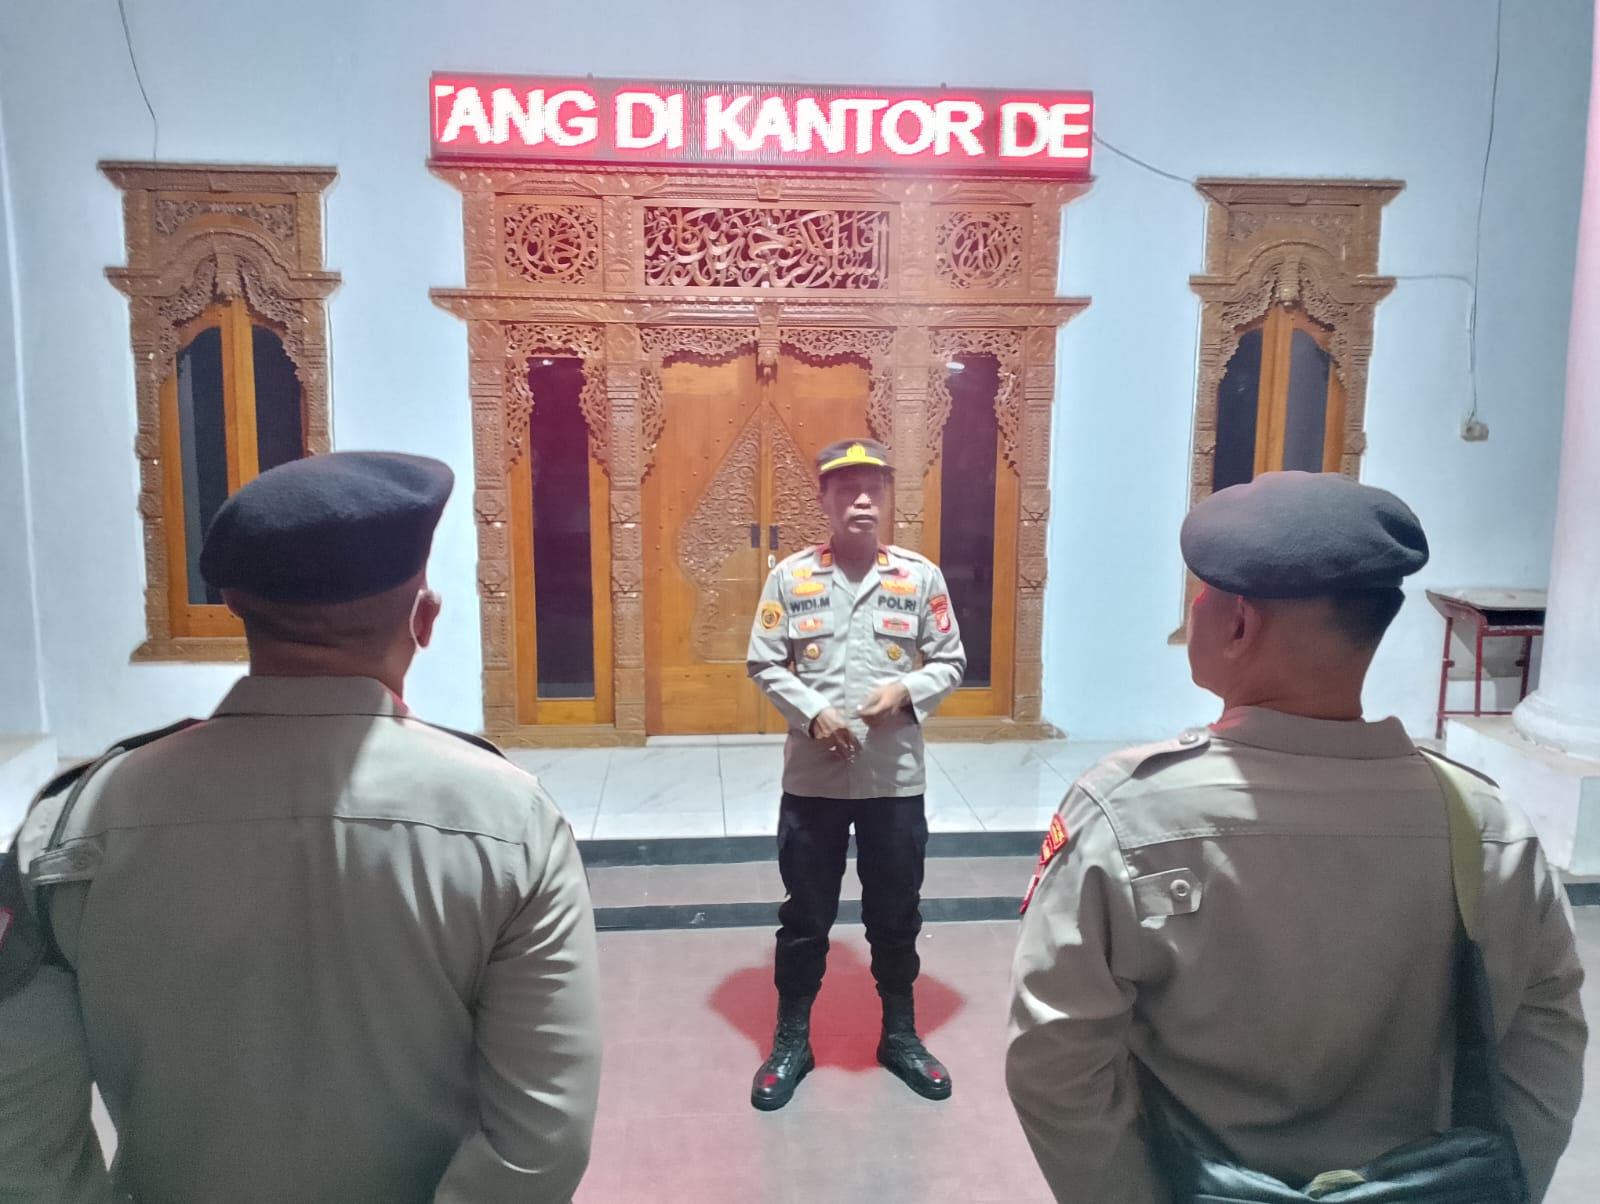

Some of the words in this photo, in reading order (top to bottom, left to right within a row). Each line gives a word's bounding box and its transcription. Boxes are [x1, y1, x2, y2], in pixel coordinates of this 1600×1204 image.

[615, 92, 684, 149] DI
[703, 94, 985, 155] KANTOR
[1000, 103, 1091, 159] DE
[878, 596, 917, 612] POLRI
